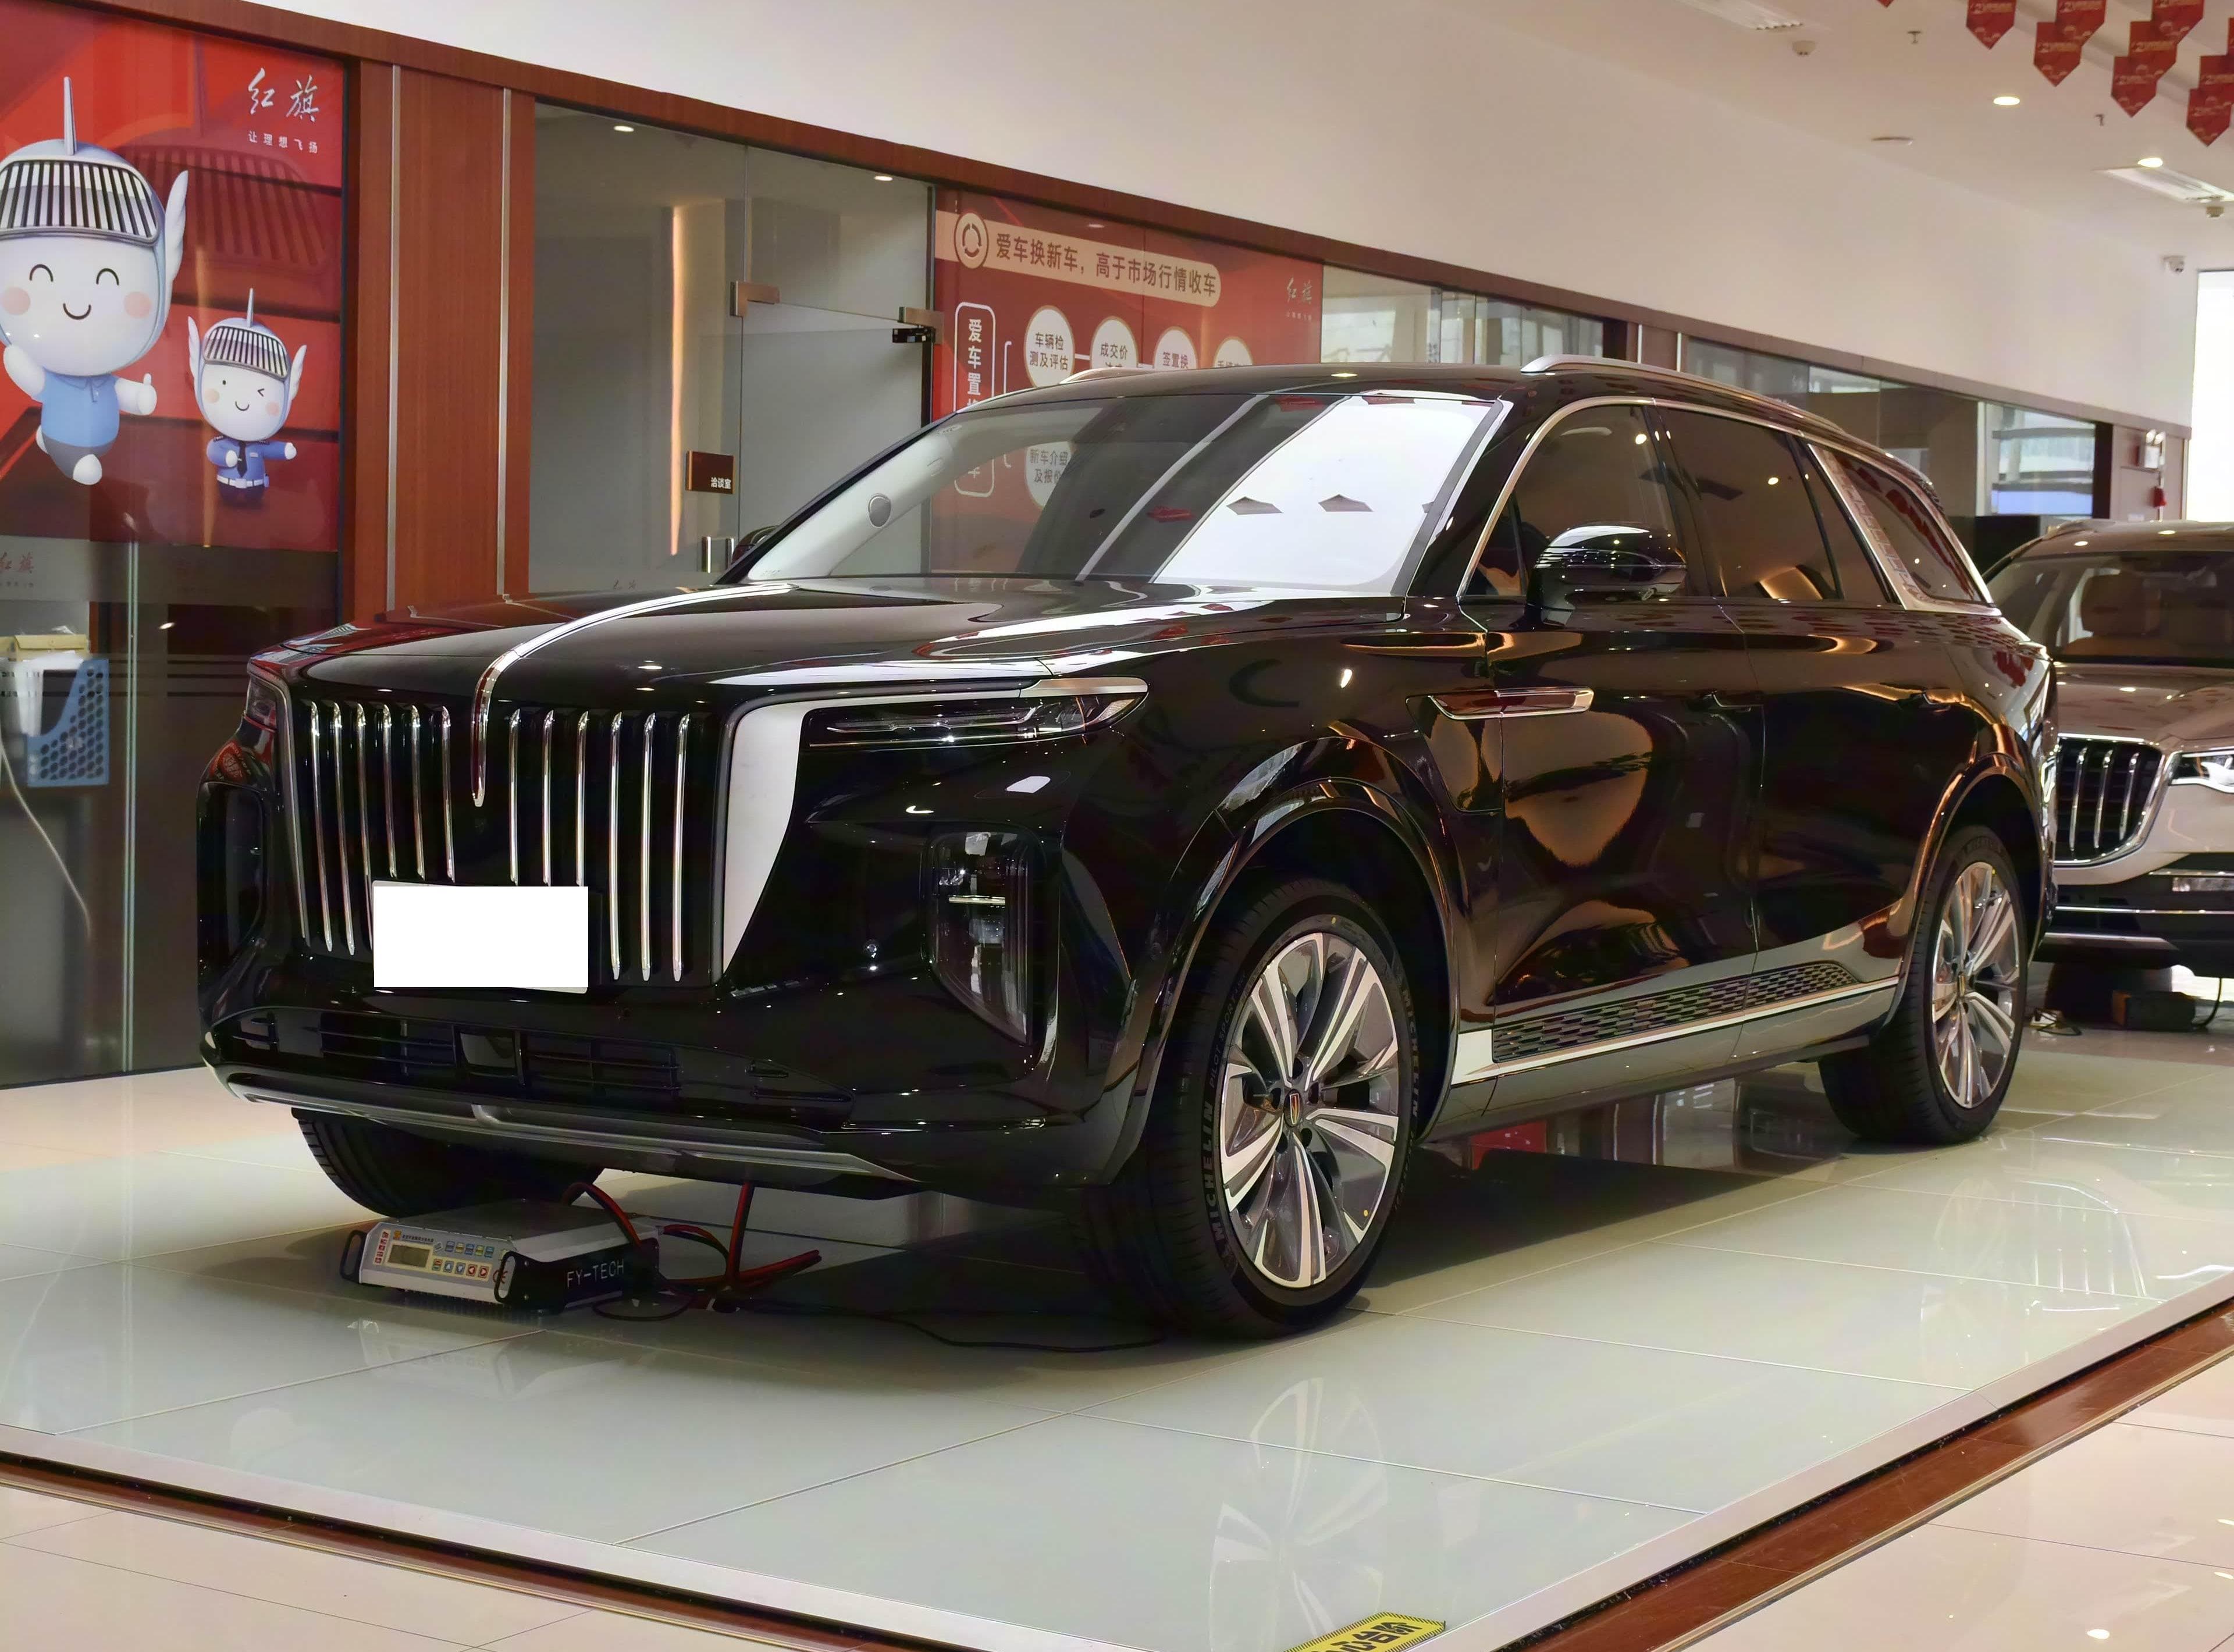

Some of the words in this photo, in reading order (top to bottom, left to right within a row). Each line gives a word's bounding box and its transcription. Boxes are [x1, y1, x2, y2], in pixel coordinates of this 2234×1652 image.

[248, 67, 319, 122] 红旗
[248, 130, 318, 154] 让理想飞扬
[997, 232, 1216, 297] 爱车换新车，高于市场行情收车
[1035, 332, 1063, 350] 车辆检
[1100, 343, 1127, 360] 成交价
[967, 319, 983, 407] 爱车置
[1030, 350, 1068, 371] 测及评估
[711, 476, 731, 489] 洽谈室
[1202, 1099, 1225, 1241] MICHELIN
[567, 1258, 624, 1288] FY-TECH
[1311, 1622, 1422, 1652] 心台阶
